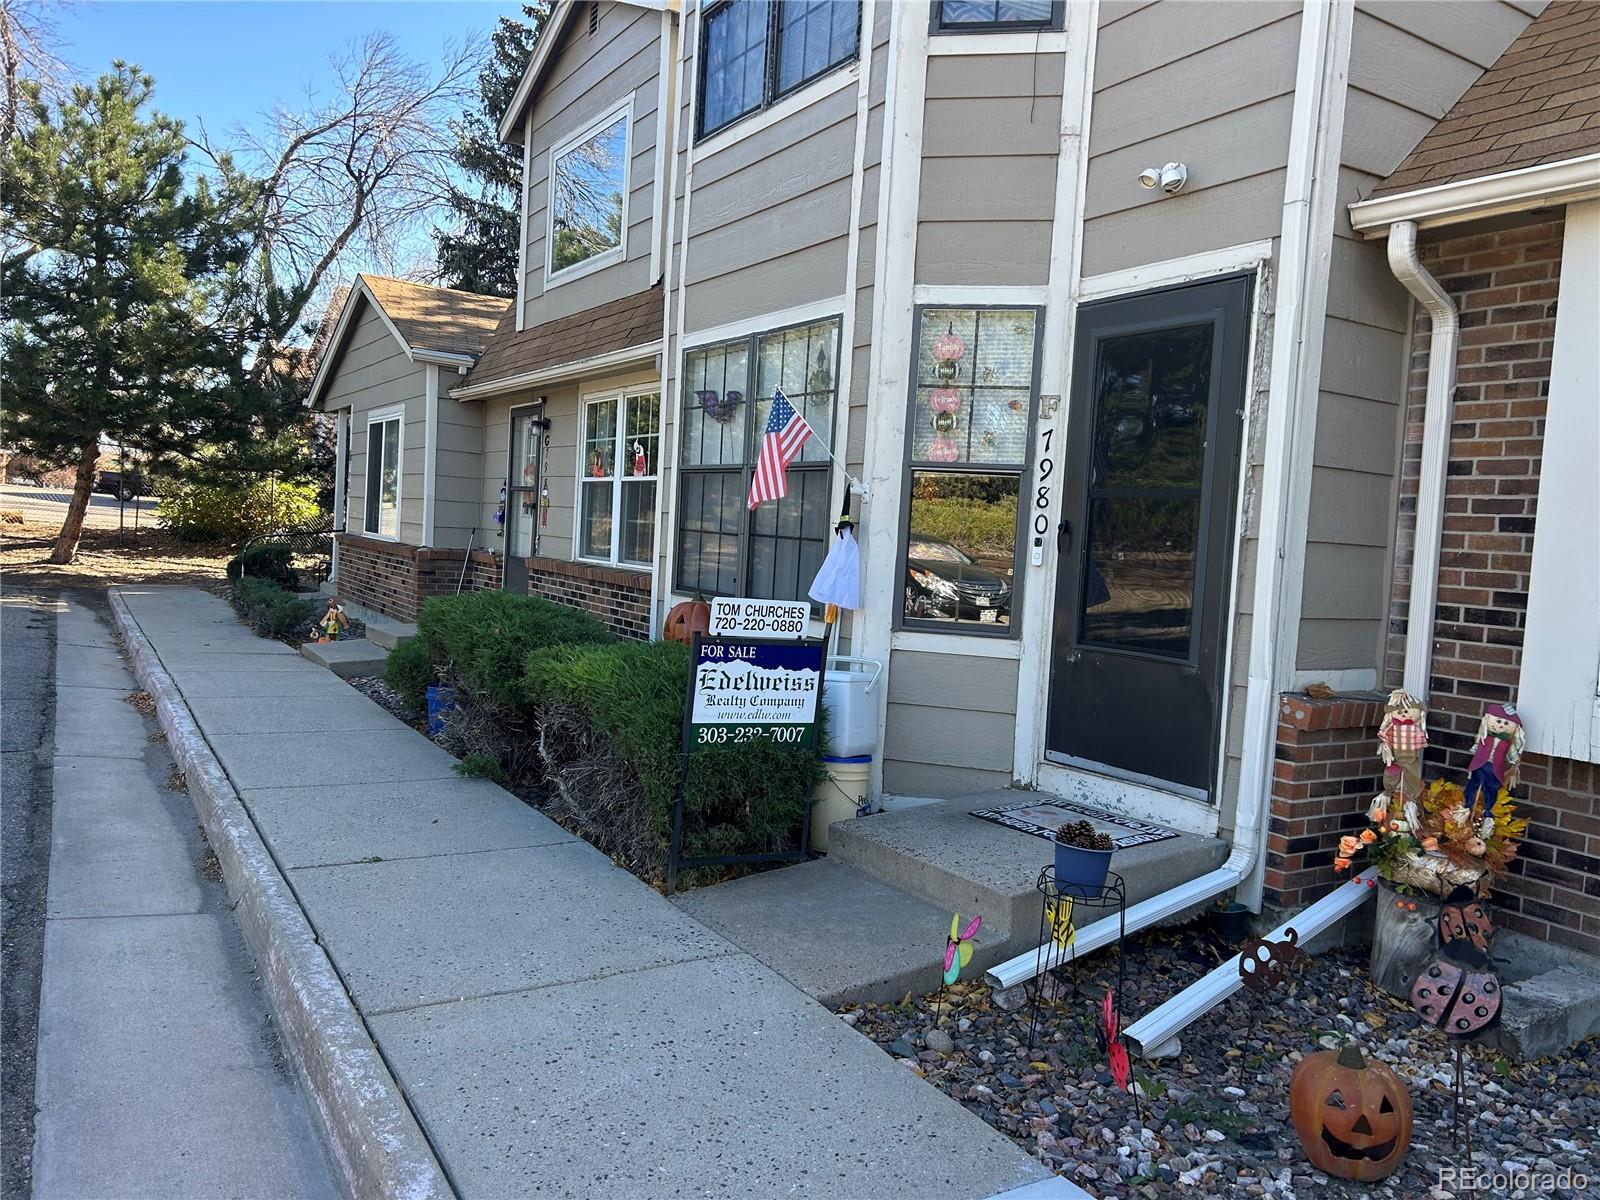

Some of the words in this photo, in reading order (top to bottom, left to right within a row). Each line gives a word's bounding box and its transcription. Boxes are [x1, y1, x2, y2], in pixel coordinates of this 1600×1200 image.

[1039, 394, 1061, 419] F
[1034, 429, 1054, 535] 7980
[717, 603, 740, 616] TOM
[745, 604, 805, 619] CHURCHES
[715, 618, 803, 632] 720-220-0880
[701, 645, 724, 657] FOR
[728, 646, 756, 658] SALE
[699, 668, 815, 694] Edelweiss
[705, 695, 747, 708] Realty
[750, 696, 805, 708] Company
[718, 709, 791, 720] www.edlw.com
